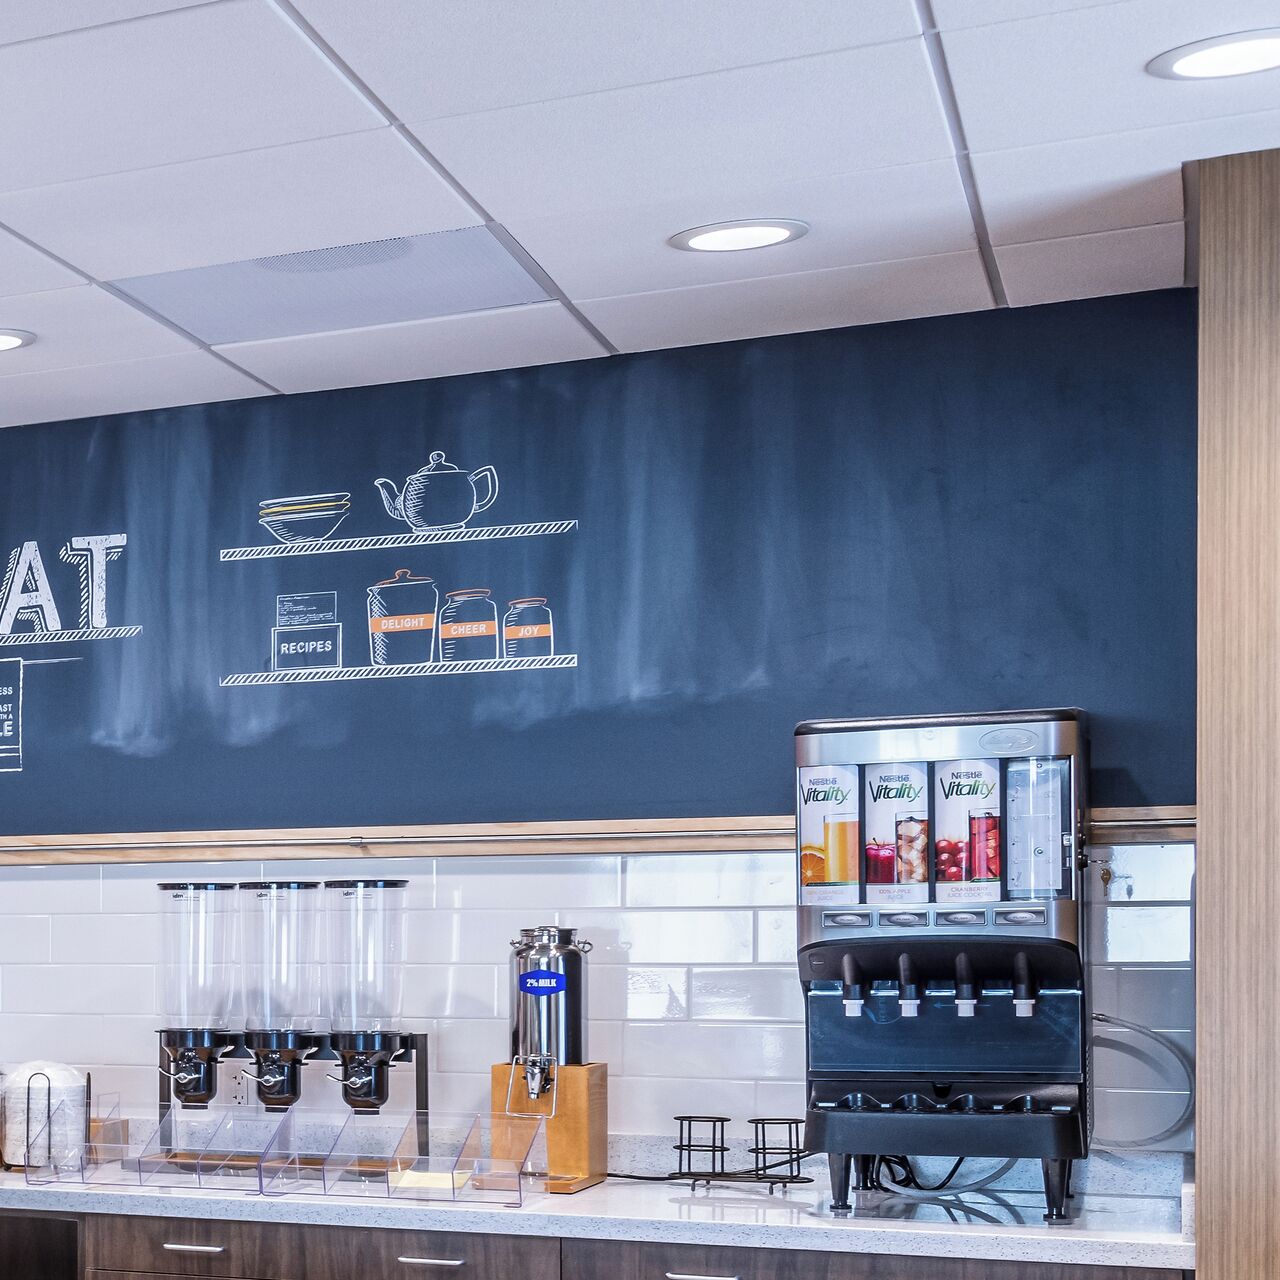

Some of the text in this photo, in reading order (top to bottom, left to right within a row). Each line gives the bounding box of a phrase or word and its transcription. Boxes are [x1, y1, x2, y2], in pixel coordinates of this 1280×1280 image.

[381, 617, 425, 629] DELIGHT
[451, 625, 486, 635] CHEER
[518, 626, 539, 636] JOY
[280, 641, 332, 655] RECIPES
[526, 979, 557, 987] 2% MILK
